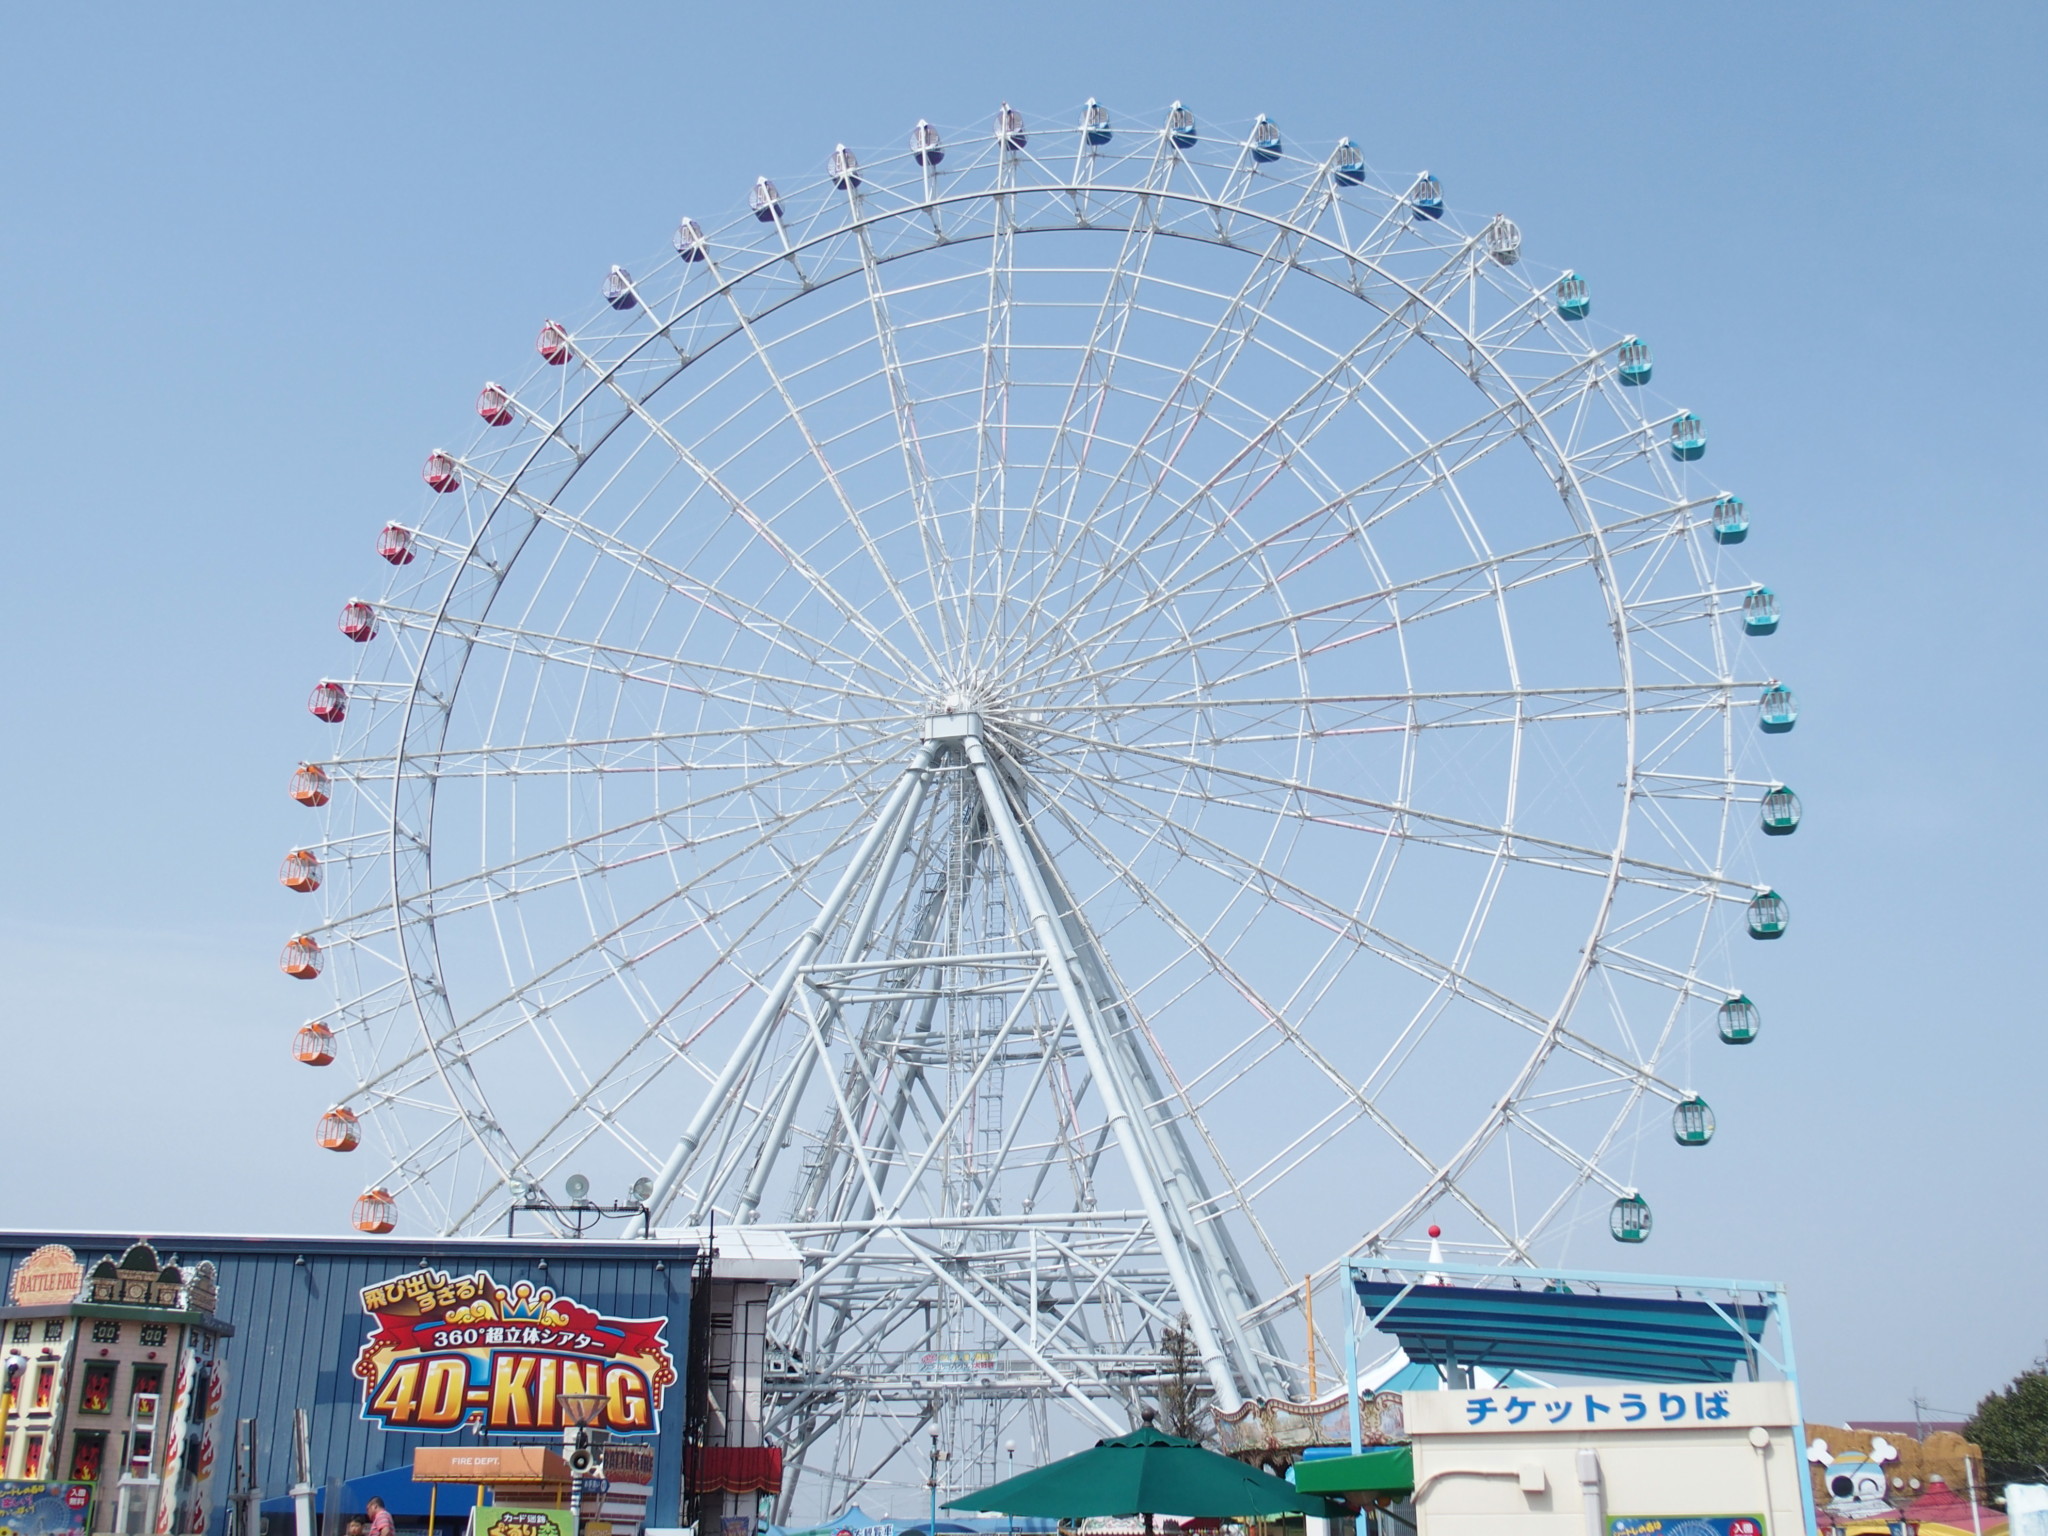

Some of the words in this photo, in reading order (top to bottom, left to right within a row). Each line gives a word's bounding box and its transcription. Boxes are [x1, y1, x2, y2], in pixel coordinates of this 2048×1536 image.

[19, 1273, 55, 1293] BATTLE
[56, 1272, 79, 1291] FIRE
[364, 1272, 447, 1310] 飛び出し
[433, 1326, 605, 1349] 360°超立体シアター
[373, 1355, 647, 1427] 4D-KING
[1466, 1389, 1731, 1425] チケットうりば
[451, 1457, 473, 1465] FIRE
[474, 1457, 500, 1465] DEPT.
